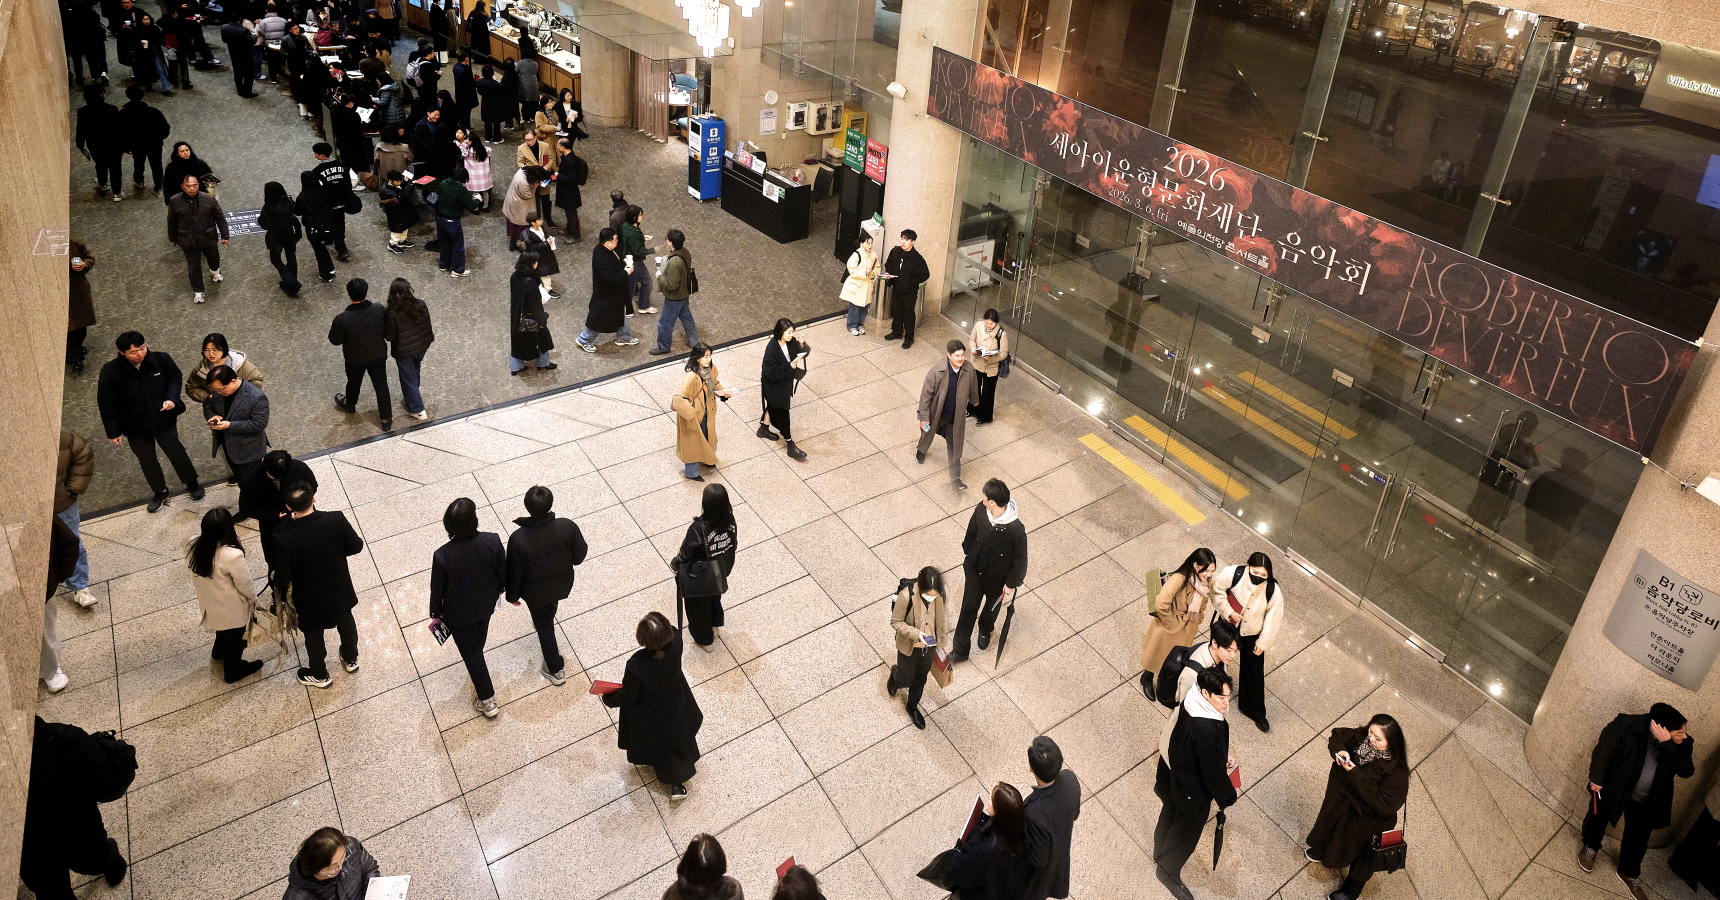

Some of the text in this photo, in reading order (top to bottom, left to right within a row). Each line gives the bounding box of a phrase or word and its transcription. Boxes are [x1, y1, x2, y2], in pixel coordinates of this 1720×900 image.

[1163, 146, 1229, 191] 2026
[1049, 131, 1371, 295] 세아이운형문화재단 음악회
[1108, 185, 1170, 222] 2026. 3. 6. fri
[1409, 247, 1669, 385] ROBERTO
[1395, 290, 1653, 443] DEVEREUX
[1659, 575, 1676, 592] B1
[1647, 585, 1720, 631] 음악당로비
